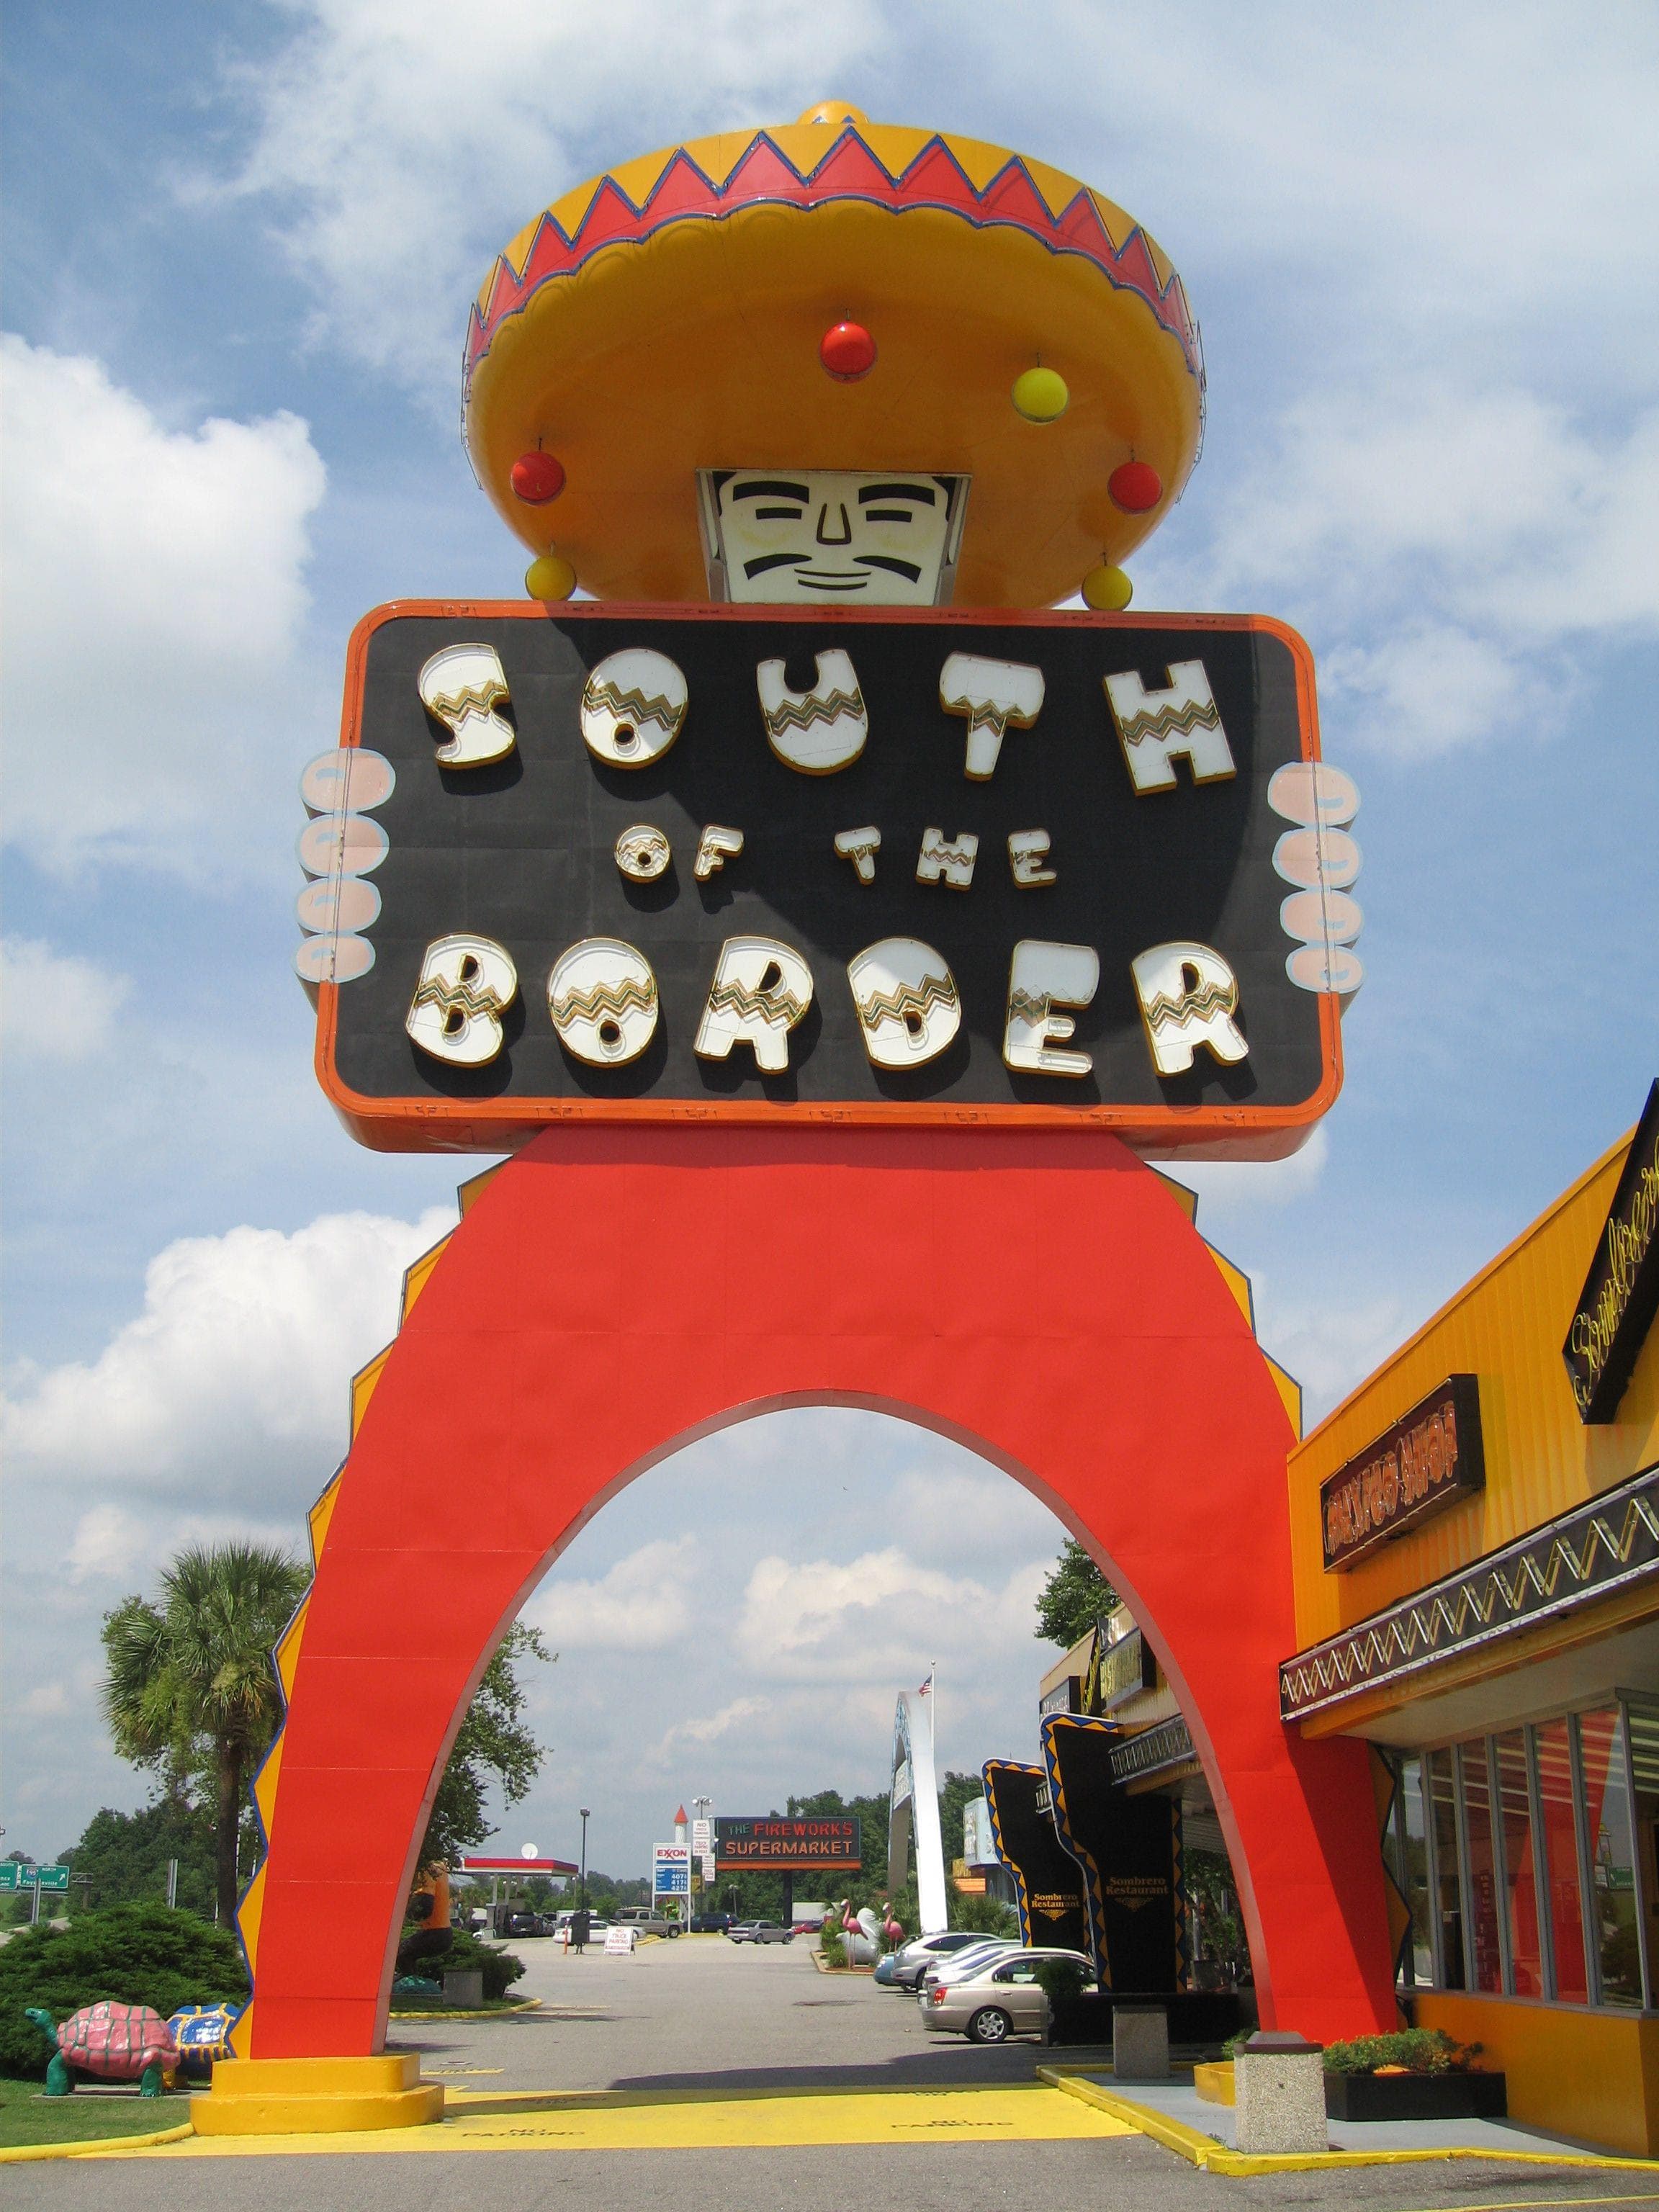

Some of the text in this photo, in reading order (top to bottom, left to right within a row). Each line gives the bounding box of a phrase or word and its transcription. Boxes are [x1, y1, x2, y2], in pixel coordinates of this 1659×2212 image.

[418, 642, 1237, 796] SOUTH
[614, 823, 1056, 890] OF THE
[405, 932, 1249, 1079] BORDER
[1573, 1136, 1659, 1405] Sombrer
[728, 1822, 853, 1836] THE FIREWORKS
[657, 1848, 687, 1860] EXXON
[725, 1841, 852, 1855] SUPERMARKET
[1110, 1876, 1166, 1886] Sombrero
[1105, 1886, 1169, 1895] Restaurant
